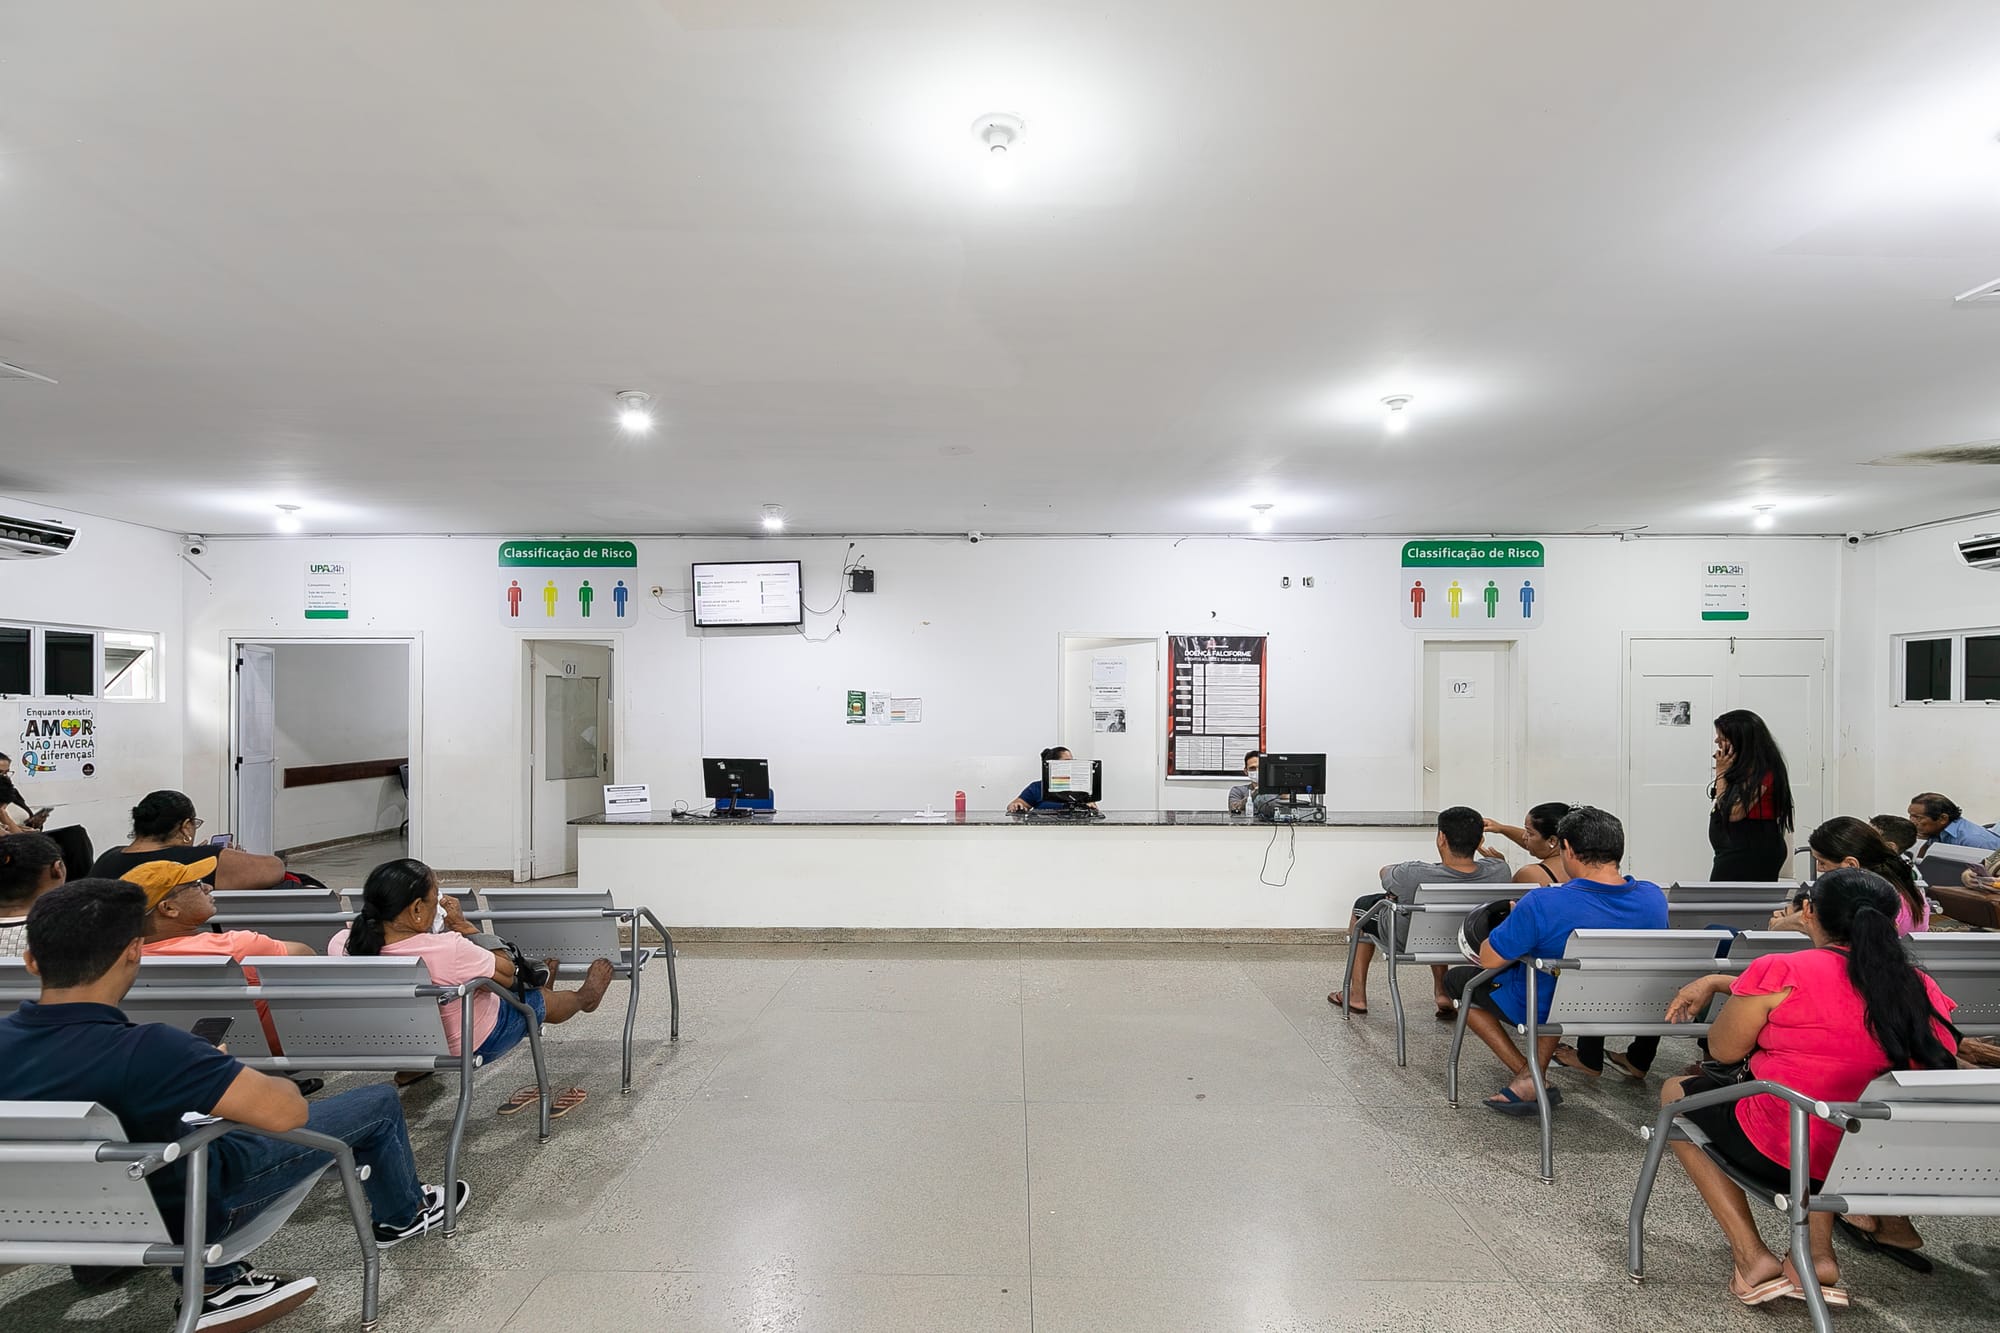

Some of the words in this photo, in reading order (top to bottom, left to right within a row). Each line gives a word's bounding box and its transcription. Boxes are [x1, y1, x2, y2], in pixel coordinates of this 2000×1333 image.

[503, 547, 580, 560] Classificação
[583, 547, 598, 558] de
[601, 547, 632, 558] Risco
[1407, 547, 1486, 560] Classificação
[1488, 547, 1505, 558] de
[1507, 547, 1540, 558] Risco
[565, 663, 576, 675] 01
[1453, 682, 1468, 694] 02
[26, 708, 66, 718] Enquanto
[26, 738, 51, 751] NÃO
[53, 736, 95, 750] HAVERÁ
[40, 749, 95, 761] diferenças!
